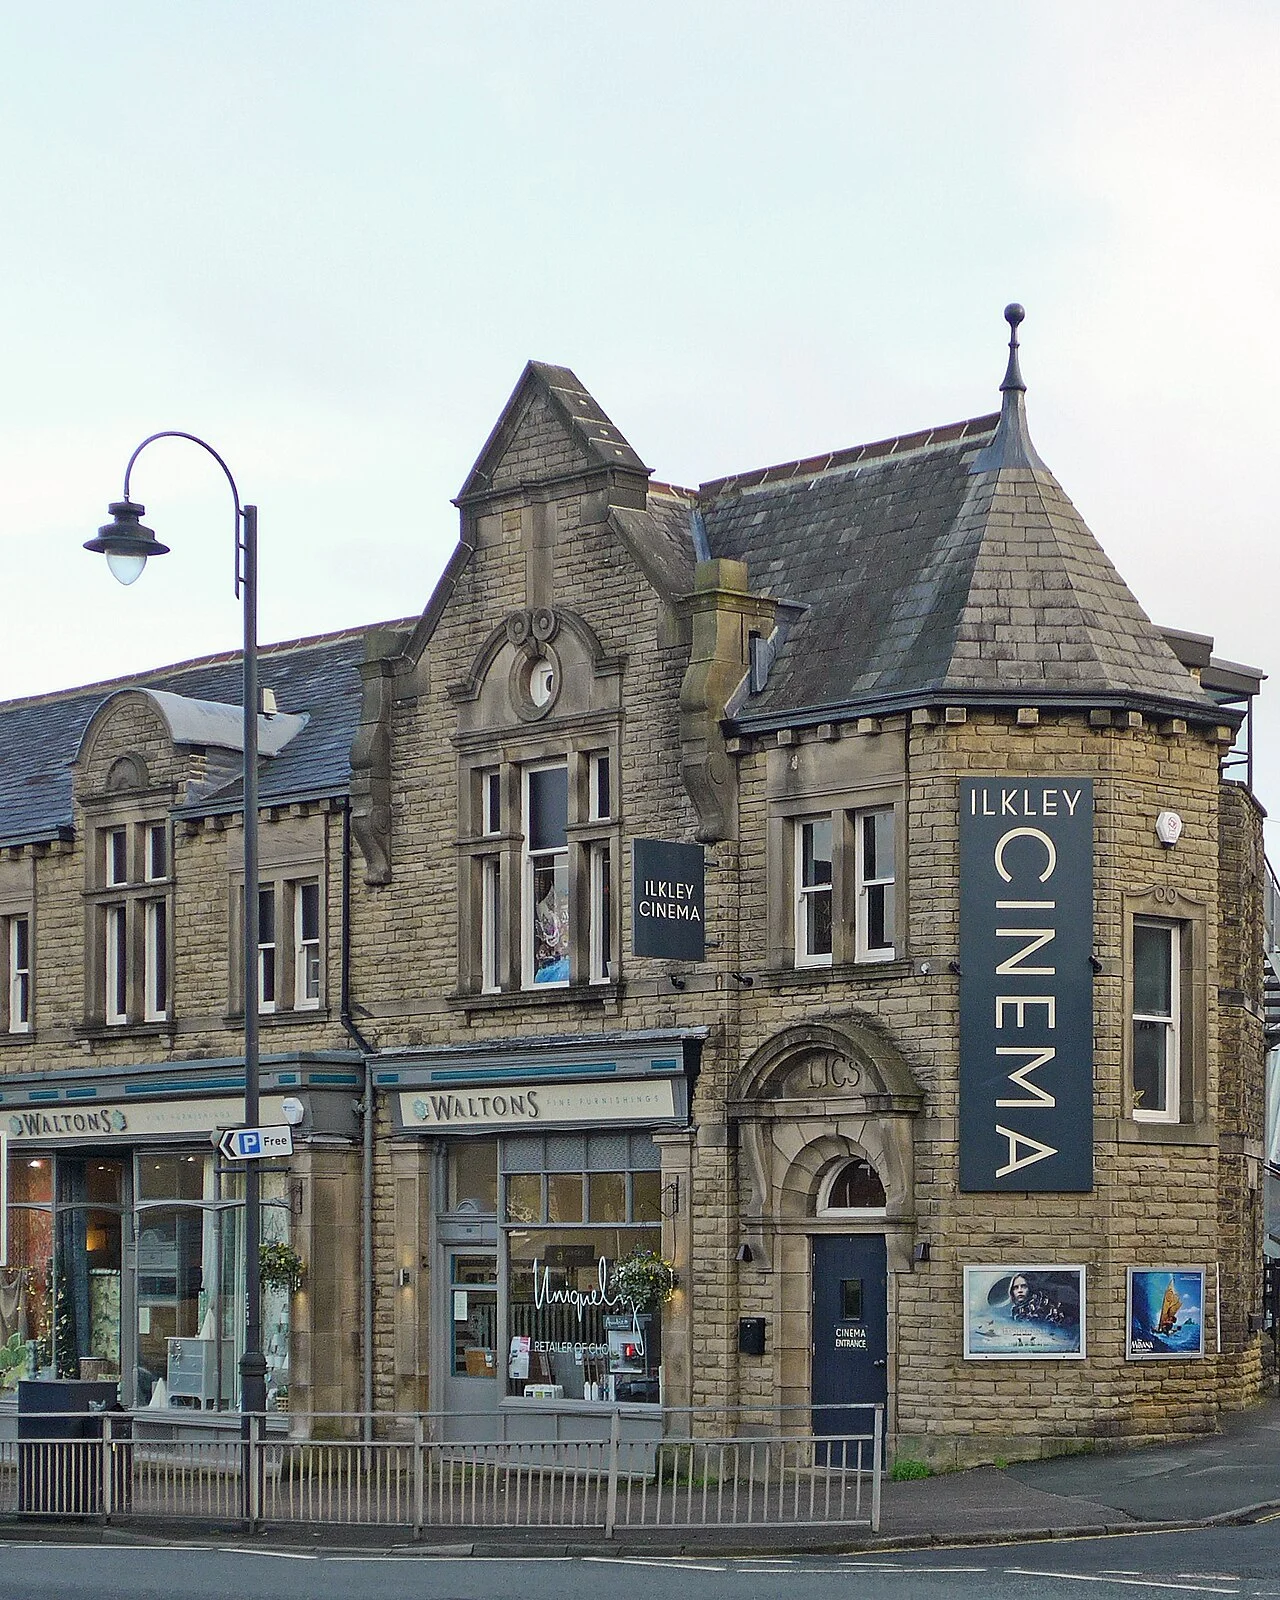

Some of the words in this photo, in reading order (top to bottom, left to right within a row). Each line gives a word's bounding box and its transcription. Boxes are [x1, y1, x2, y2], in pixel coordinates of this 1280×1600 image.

[971, 788, 1082, 816] ILKLEY
[645, 880, 694, 900] ILKLEY
[639, 900, 701, 921] CINEMA
[993, 826, 1059, 1180] CINEMA
[428, 1090, 539, 1121] WALTONS
[22, 1109, 112, 1136] WALTONS
[243, 1134, 258, 1153] P
[263, 1136, 287, 1147] Free
[835, 1328, 867, 1338] CINEMA
[534, 1341, 573, 1353] RETAILER
[574, 1342, 588, 1353] OF
[835, 1338, 867, 1349] ENTRANCE
